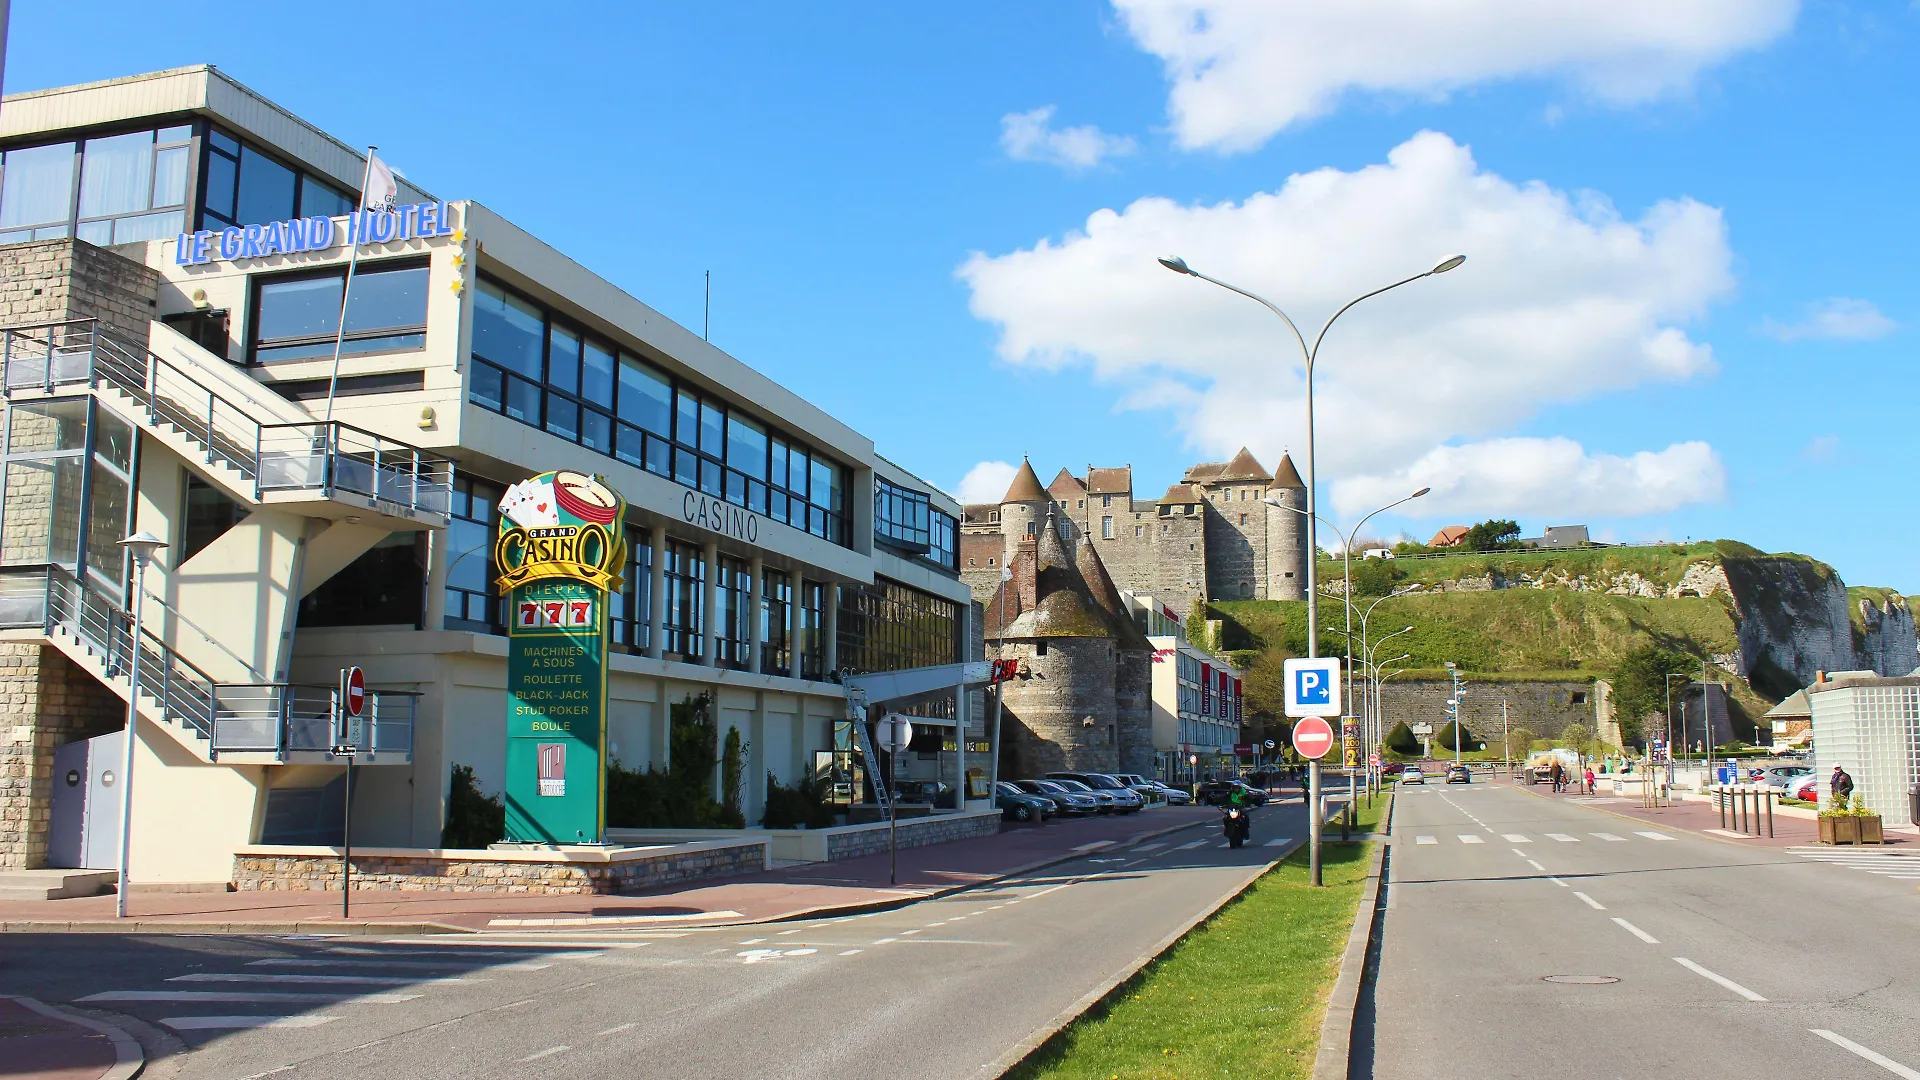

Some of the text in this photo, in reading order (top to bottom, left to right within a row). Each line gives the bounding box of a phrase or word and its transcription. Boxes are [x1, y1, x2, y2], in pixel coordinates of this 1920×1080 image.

[176, 201, 456, 266] LE GRAND HOTEL
[683, 491, 758, 543] CASINO
[529, 528, 576, 538] GRAND
[497, 523, 608, 580] CASINO
[525, 584, 587, 596] DIEPPE
[523, 646, 584, 657] MACHINES
[543, 657, 575, 668] SOUS
[523, 674, 583, 684] ROULETTE
[1301, 671, 1320, 698] P
[515, 690, 589, 700] BLACK-JACK
[516, 705, 589, 715] STUD POKER
[532, 721, 571, 731] BOULE
